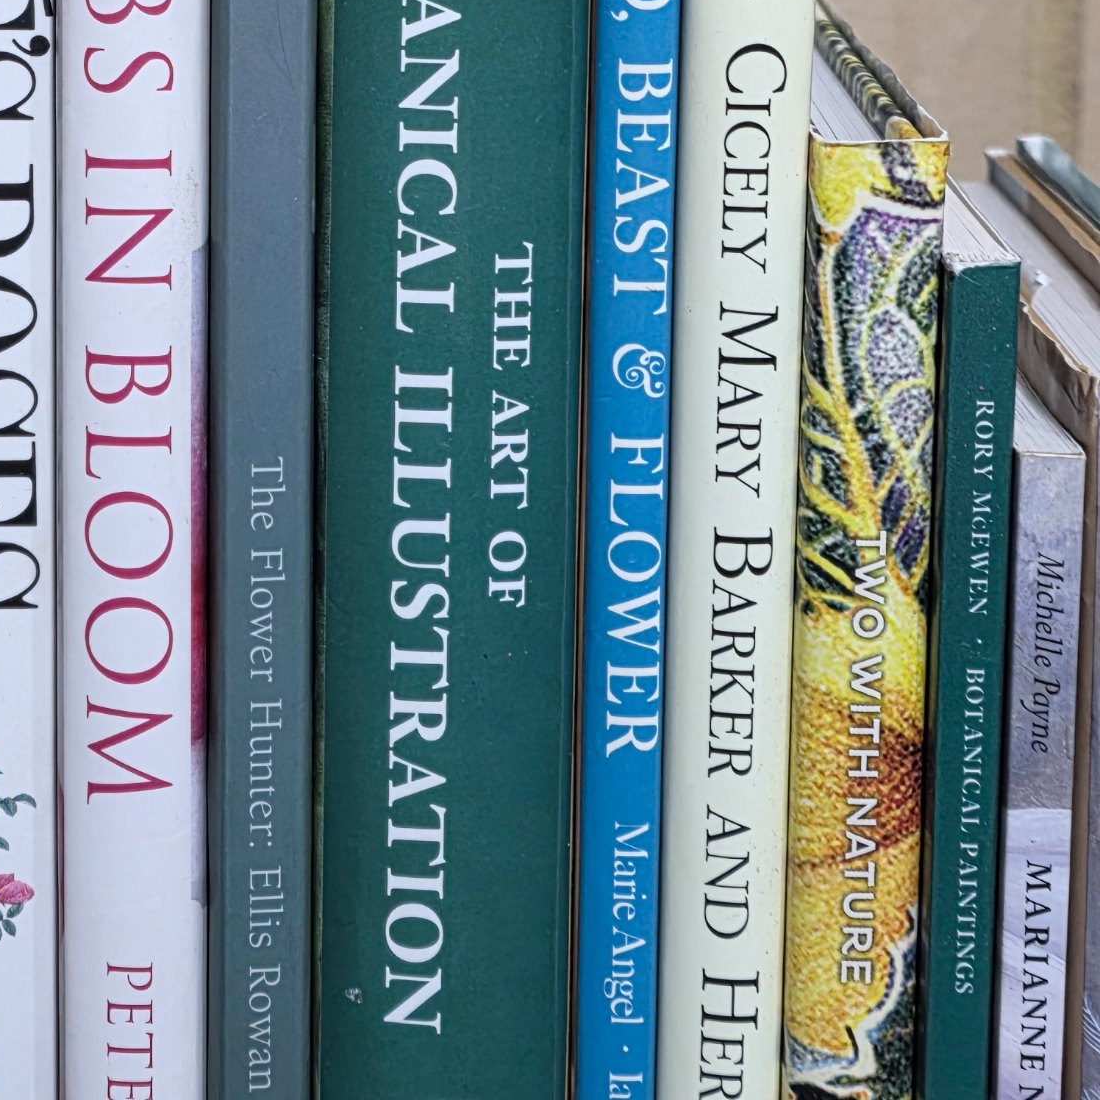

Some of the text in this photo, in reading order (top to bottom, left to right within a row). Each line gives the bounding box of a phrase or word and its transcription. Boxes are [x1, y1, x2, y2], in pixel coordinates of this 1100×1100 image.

[84, 148, 173, 291] IN
[611, 57, 673, 316] BEAST
[720, 41, 787, 274] CICELY
[487, 241, 534, 608] THE ART OF
[612, 342, 666, 400] &
[714, 300, 780, 499] MARY
[973, 399, 995, 482] RORY
[84, 344, 174, 805] BLOOM
[605, 431, 665, 758] FLOWER
[707, 525, 774, 779] BARKER
[1019, 550, 1066, 754] Michelle Payne
[248, 456, 287, 1093] The Flower Hunter: Ellis Rowan
[384, 365, 453, 1035] ILLUSTRATION
[840, 530, 888, 985] TWO WITH NATURE
[603, 820, 651, 1025] Marie Angel
[704, 803, 752, 940] AND
[954, 668, 985, 995] BOTANICAL PAINTINGS
[1018, 859, 1053, 1071] MARIANNE
